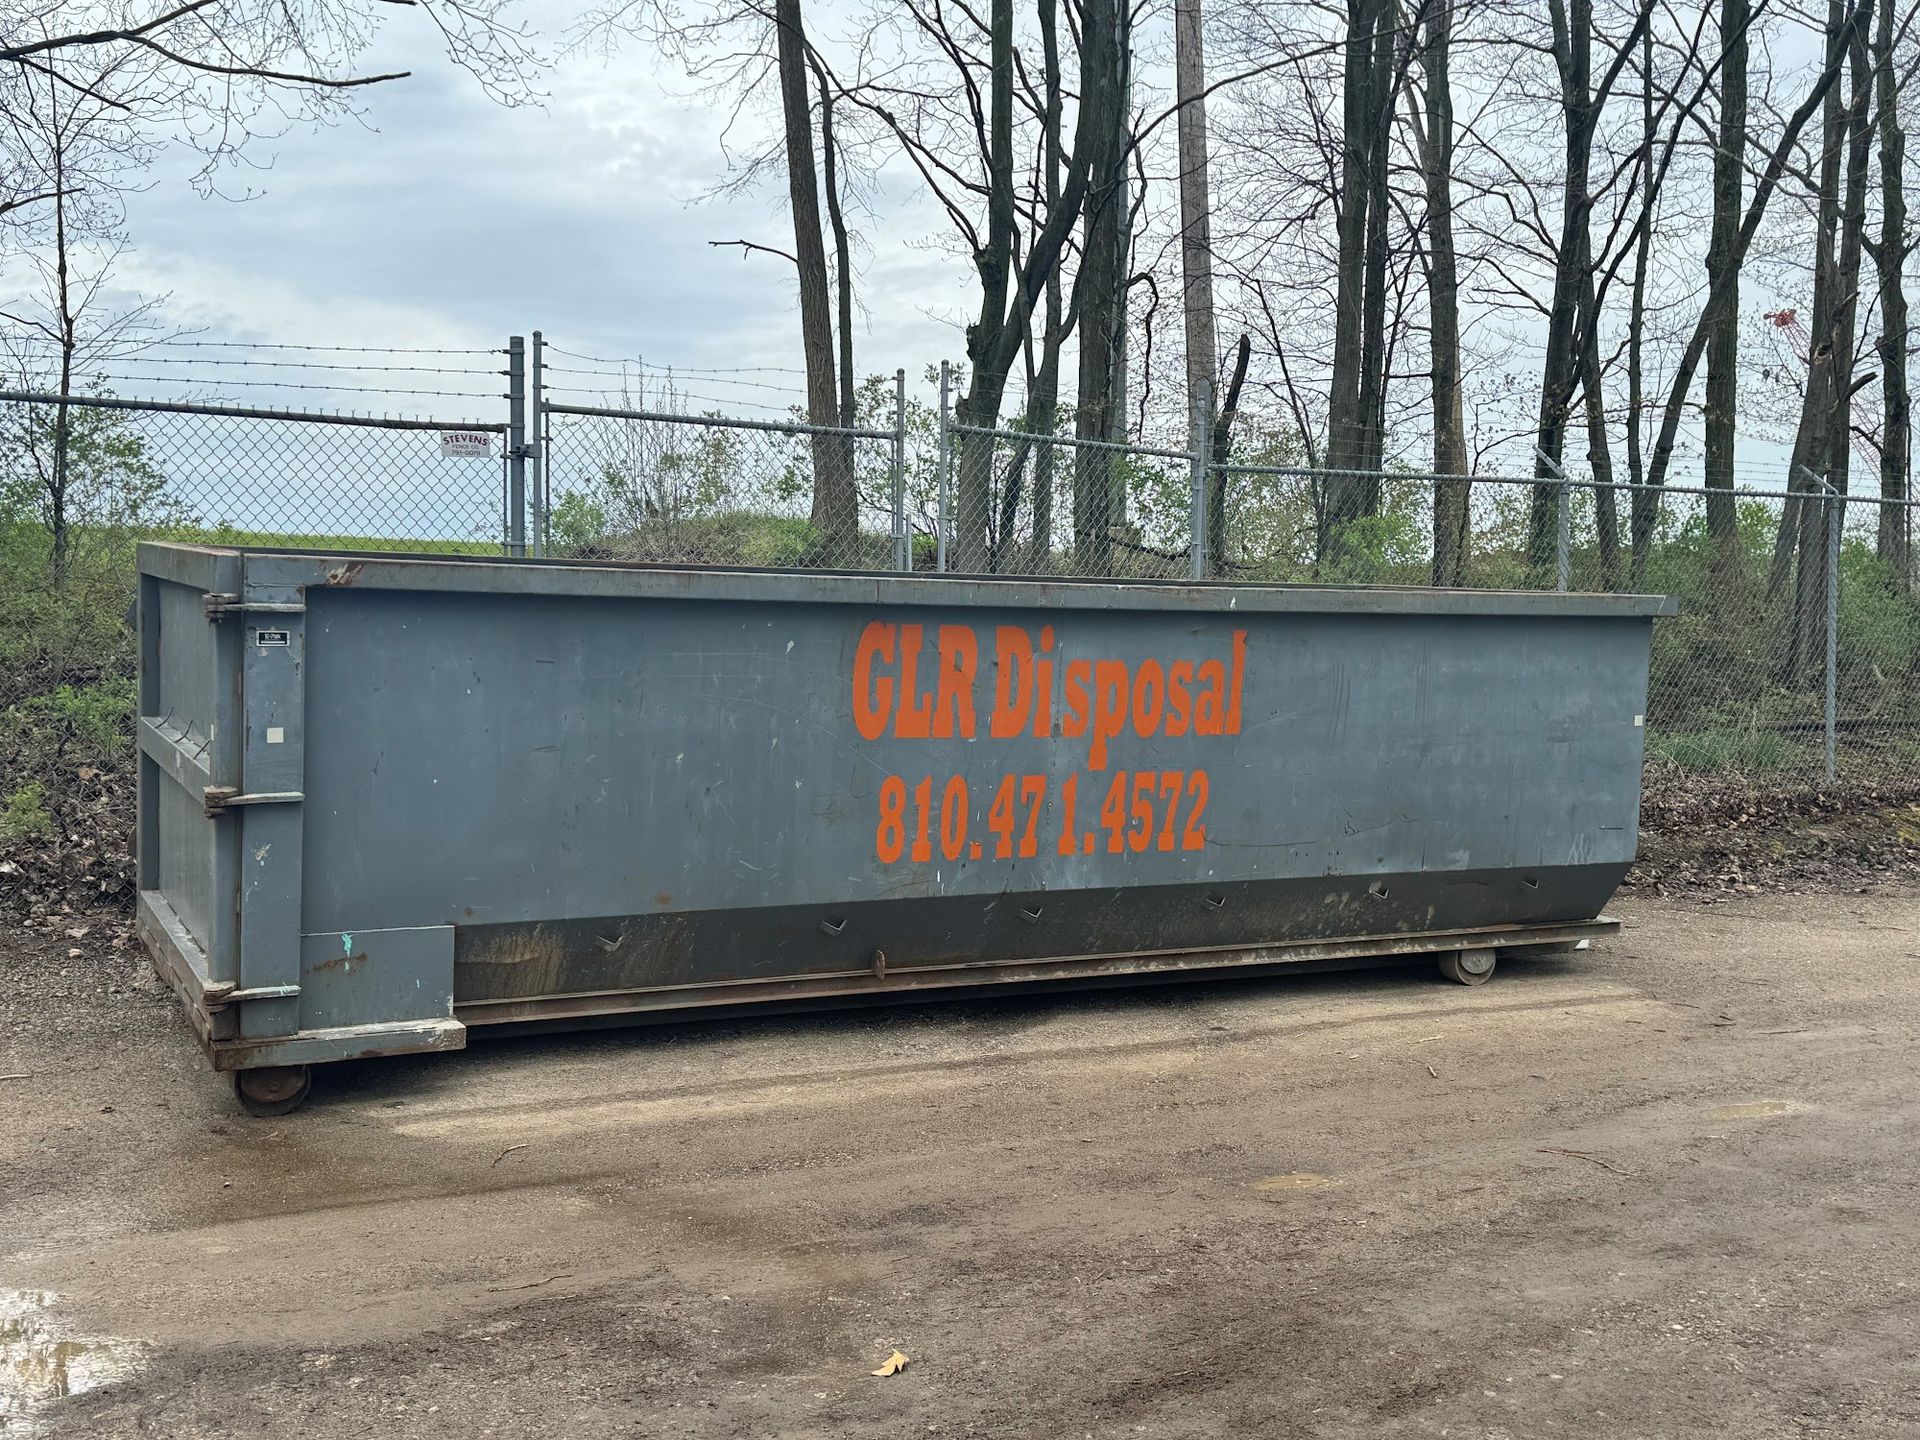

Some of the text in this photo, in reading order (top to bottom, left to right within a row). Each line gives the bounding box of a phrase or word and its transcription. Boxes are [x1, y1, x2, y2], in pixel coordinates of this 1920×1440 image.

[443, 434, 488, 446] STEVENS
[852, 620, 1248, 771] GLR Disposal
[876, 769, 1210, 864] 810.471.4572
